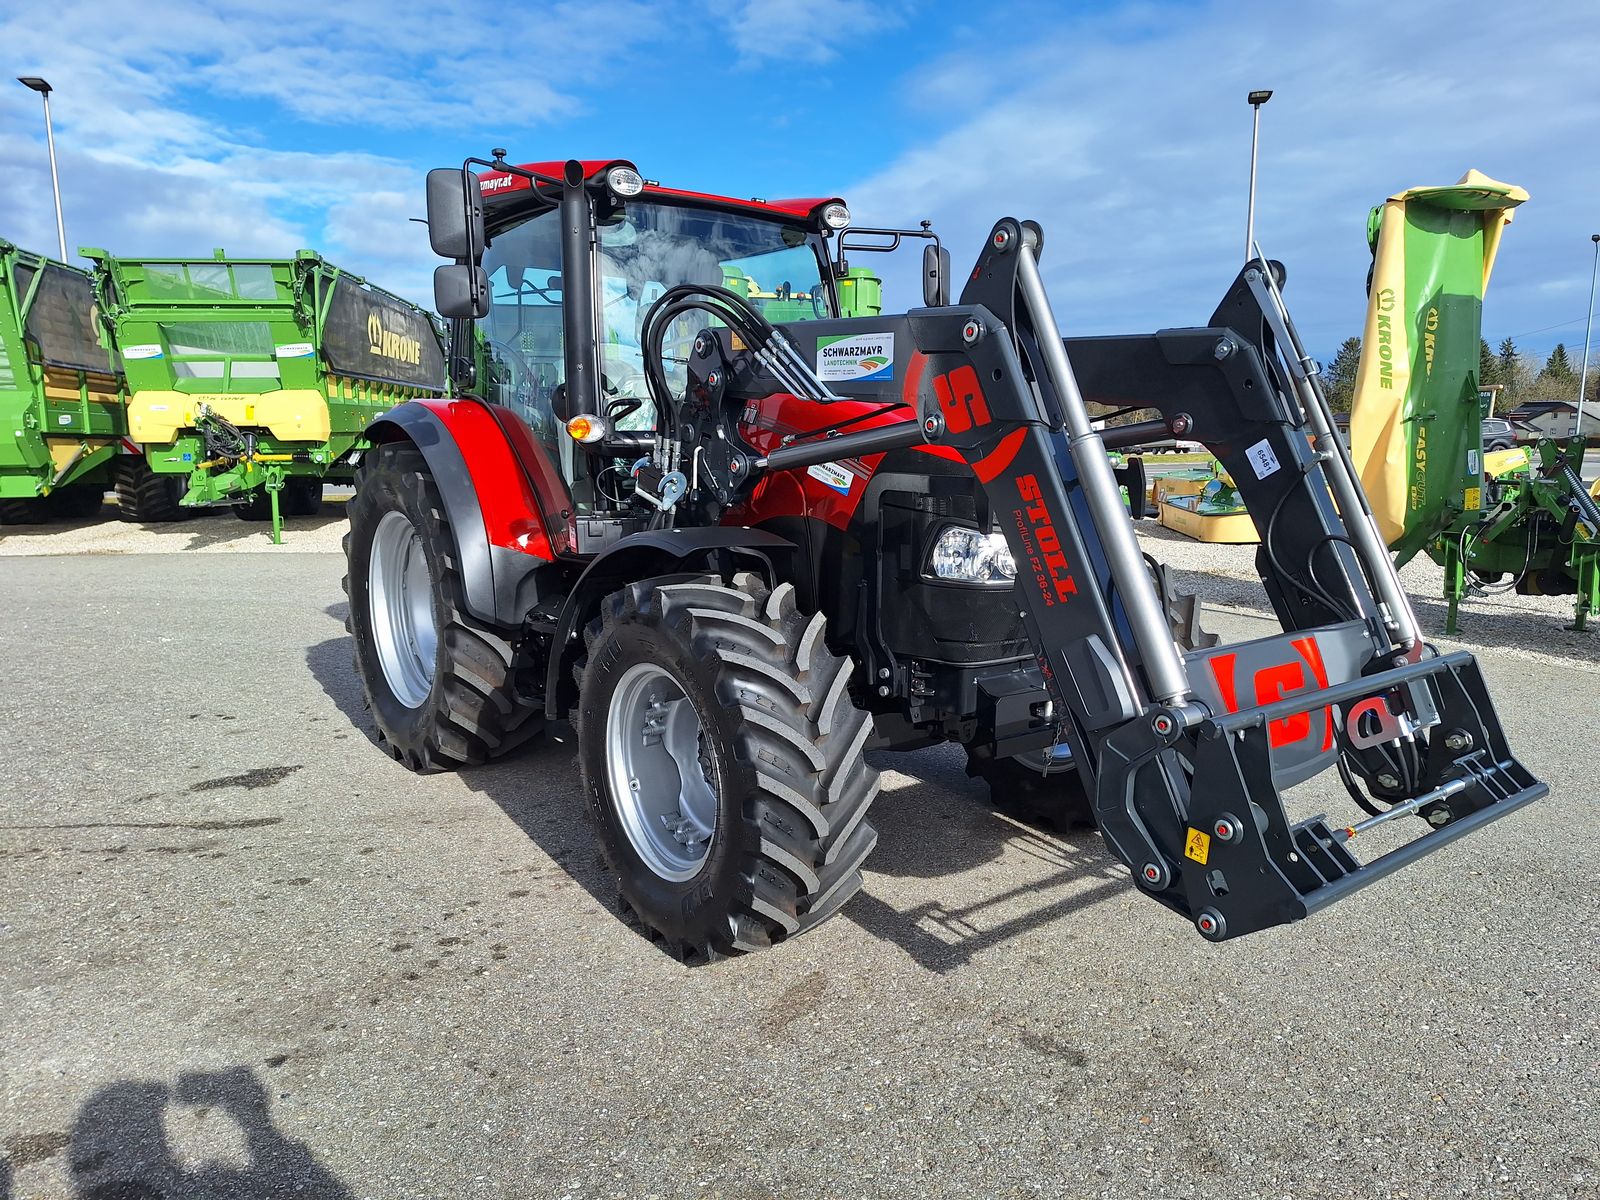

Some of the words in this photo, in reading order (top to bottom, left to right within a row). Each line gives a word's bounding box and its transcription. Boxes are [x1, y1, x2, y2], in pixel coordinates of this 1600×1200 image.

[382, 330, 421, 365] KRONE
[823, 345, 883, 357] SCHWARZMAYR
[1377, 314, 1393, 390] KRONE
[1257, 449, 1272, 472] 65481
[1013, 509, 1034, 555] ProfiLine
[1030, 556, 1042, 572] FZ
[1036, 574, 1054, 607] 36-24
[1015, 473, 1079, 603] STOLL
